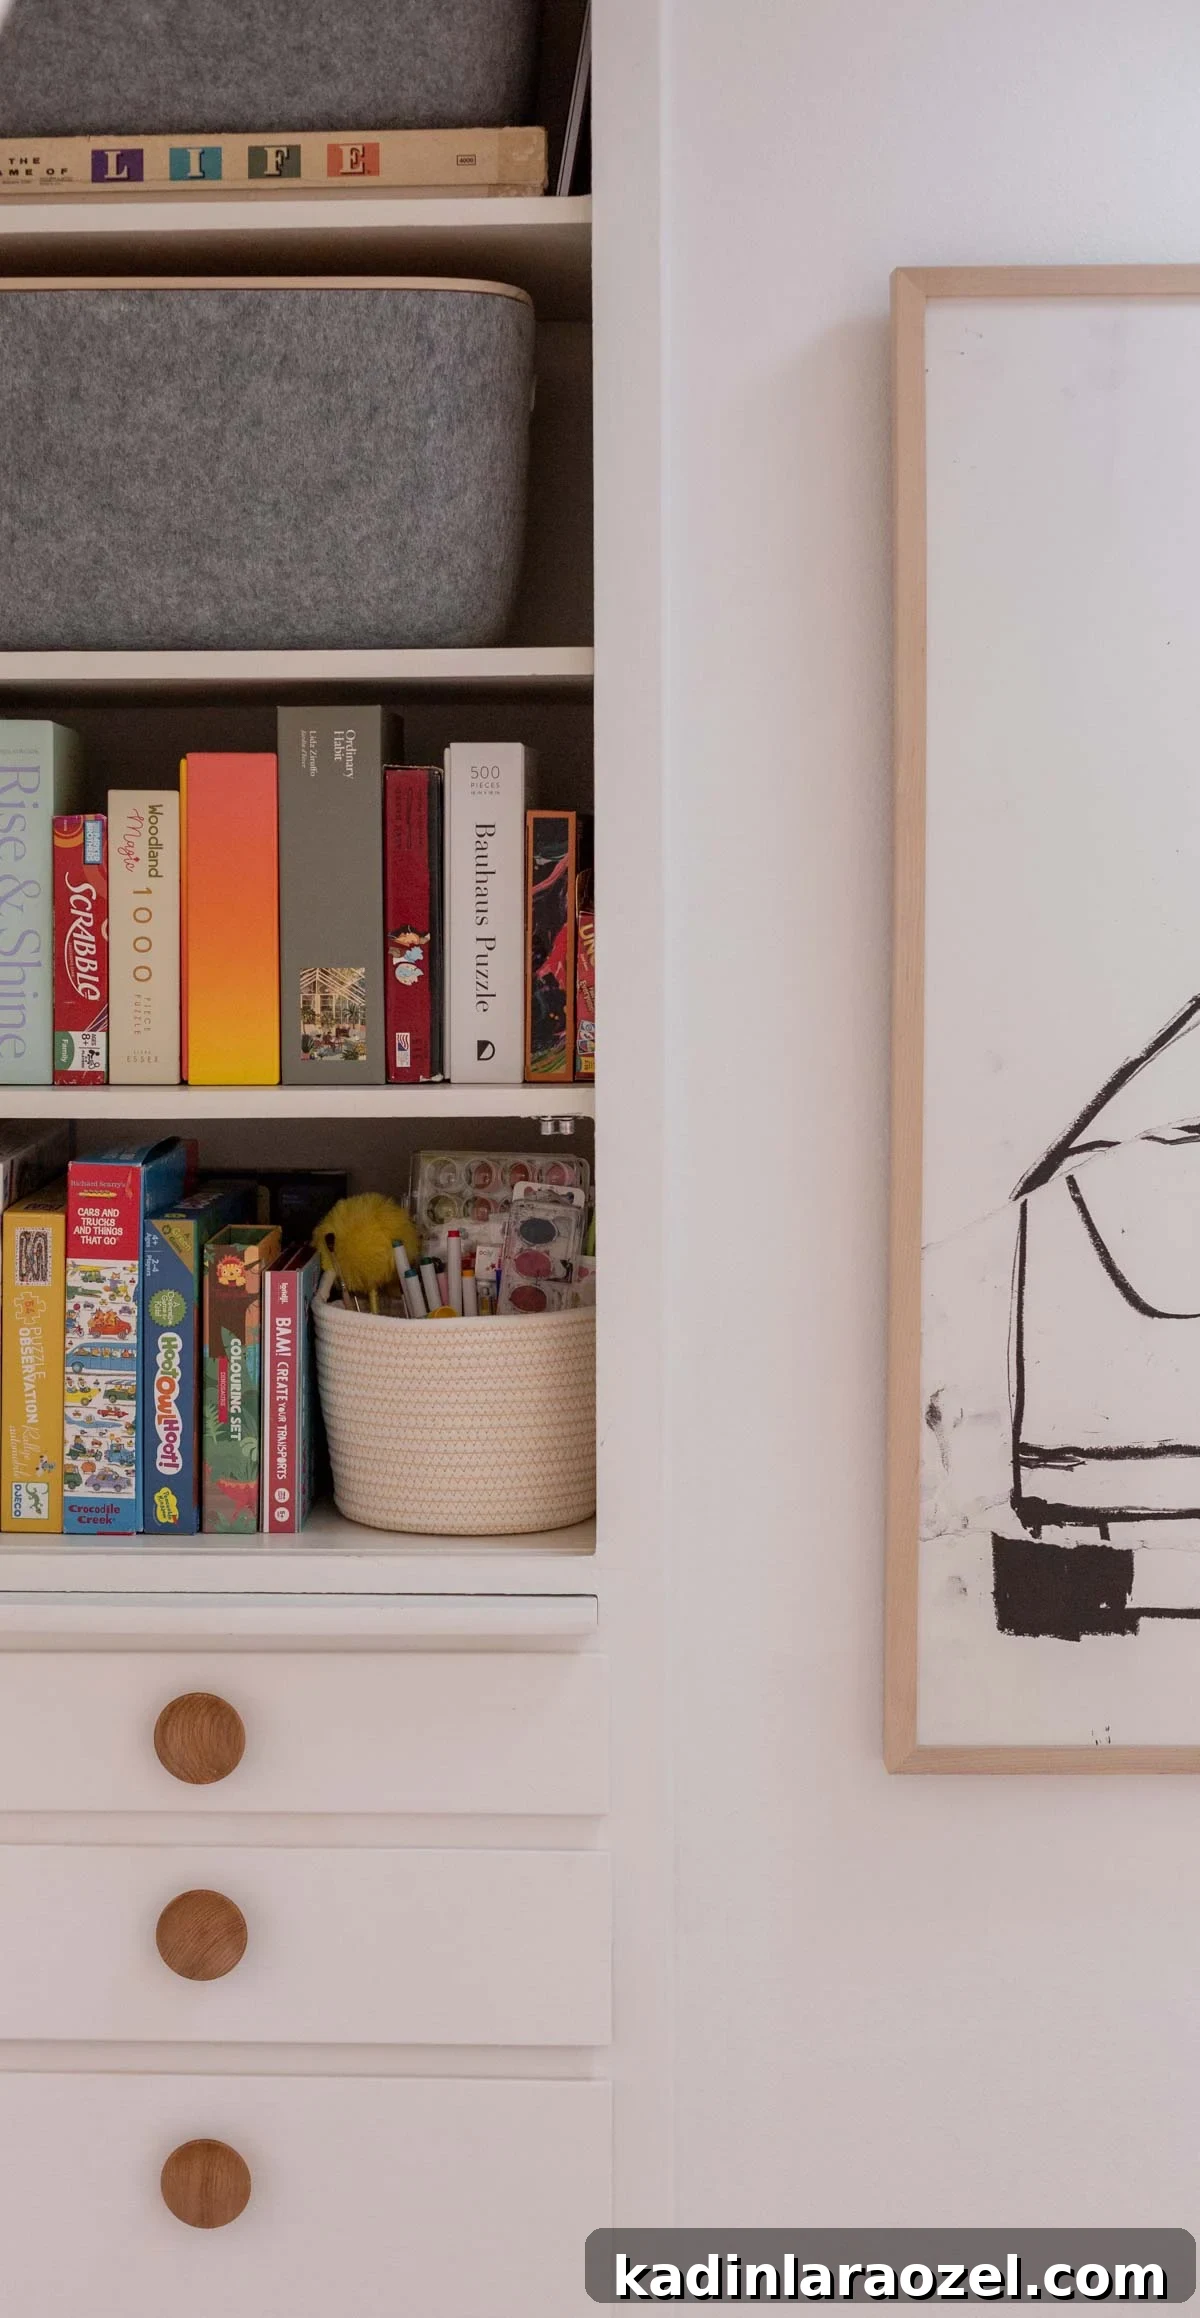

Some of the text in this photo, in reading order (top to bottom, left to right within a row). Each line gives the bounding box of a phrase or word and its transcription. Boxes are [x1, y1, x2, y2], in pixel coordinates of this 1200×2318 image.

[8, 157, 41, 165] THE
[46, 168, 69, 176] OF
[333, 730, 345, 761] Habit
[342, 729, 357, 780] Ordinary
[471, 765, 500, 780] 500
[0, 766, 41, 862] Rise
[117, 809, 144, 873] Magic
[147, 804, 163, 878] Woodland
[0, 873, 42, 918] &
[475, 822, 497, 1014] Bauhaus Puzzle
[132, 887, 153, 983] 1000
[0, 929, 42, 1059] Shine
[134, 994, 142, 1036] PUZZLE
[143, 997, 151, 1032] PIECE
[61, 1039, 69, 1063] Family
[81, 1033, 91, 1046] 8+
[71, 1179, 98, 1187] Richard
[77, 1208, 120, 1217] CARS AND
[81, 1217, 116, 1227] TRUCKS
[73, 1226, 123, 1236] AND THINGS
[80, 1235, 117, 1245] THAT GO
[145, 1232, 153, 1248] Ages
[152, 1234, 159, 1245] 4+
[172, 1227, 192, 1251] Green
[145, 1254, 153, 1277] Players
[152, 1258, 160, 1272] 2-4
[275, 1317, 292, 1357] BAM!
[30, 1327, 46, 1379] PUZZLE
[18, 1327, 39, 1424] OBSERVATION
[276, 1361, 290, 1401] CREATE
[230, 1338, 242, 1441] COLOURING SET
[278, 1402, 288, 1423] YOUR
[276, 1424, 288, 1480] TRANSPORTS
[13, 1484, 22, 1517] DJECO
[68, 1503, 121, 1514] Crocodile
[76, 1514, 112, 1524] Creek
